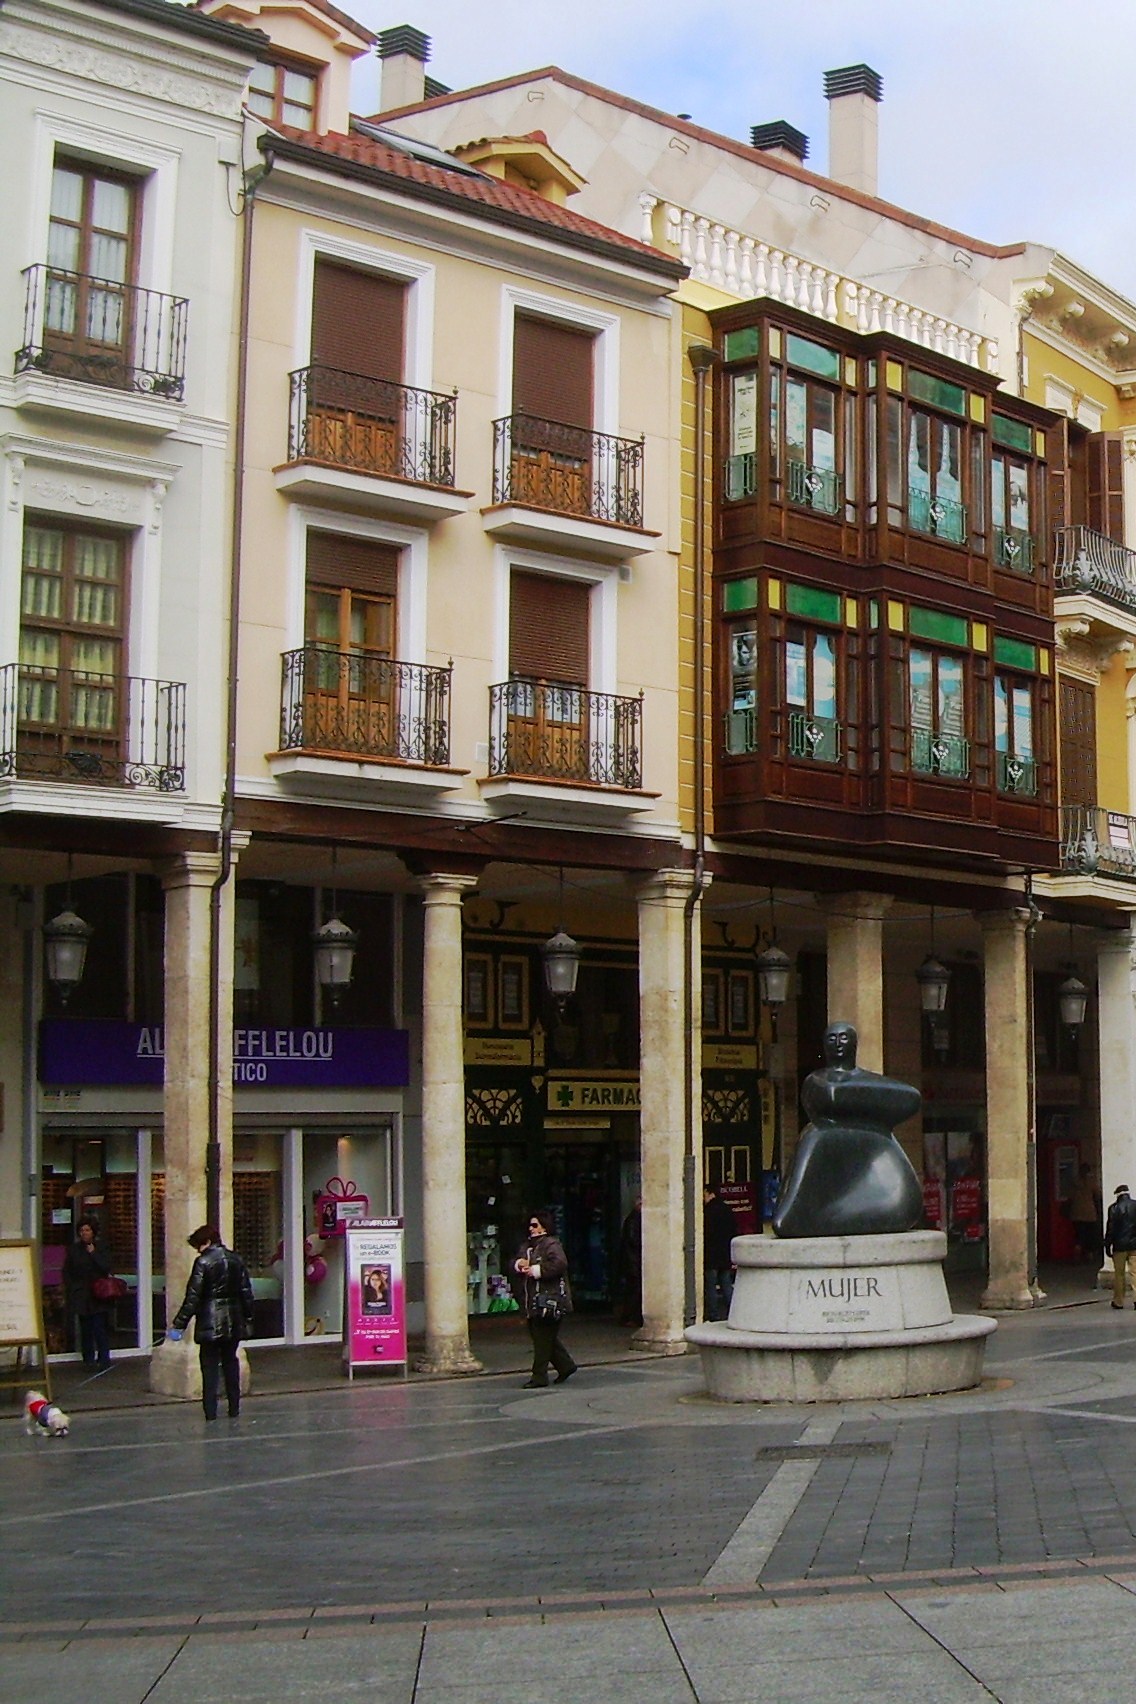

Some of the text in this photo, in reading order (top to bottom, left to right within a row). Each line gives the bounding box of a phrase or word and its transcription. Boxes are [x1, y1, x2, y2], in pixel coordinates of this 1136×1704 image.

[233, 1029, 333, 1058] FFLELOU
[233, 1063, 267, 1081] TICO
[806, 1277, 883, 1303] MUJER
